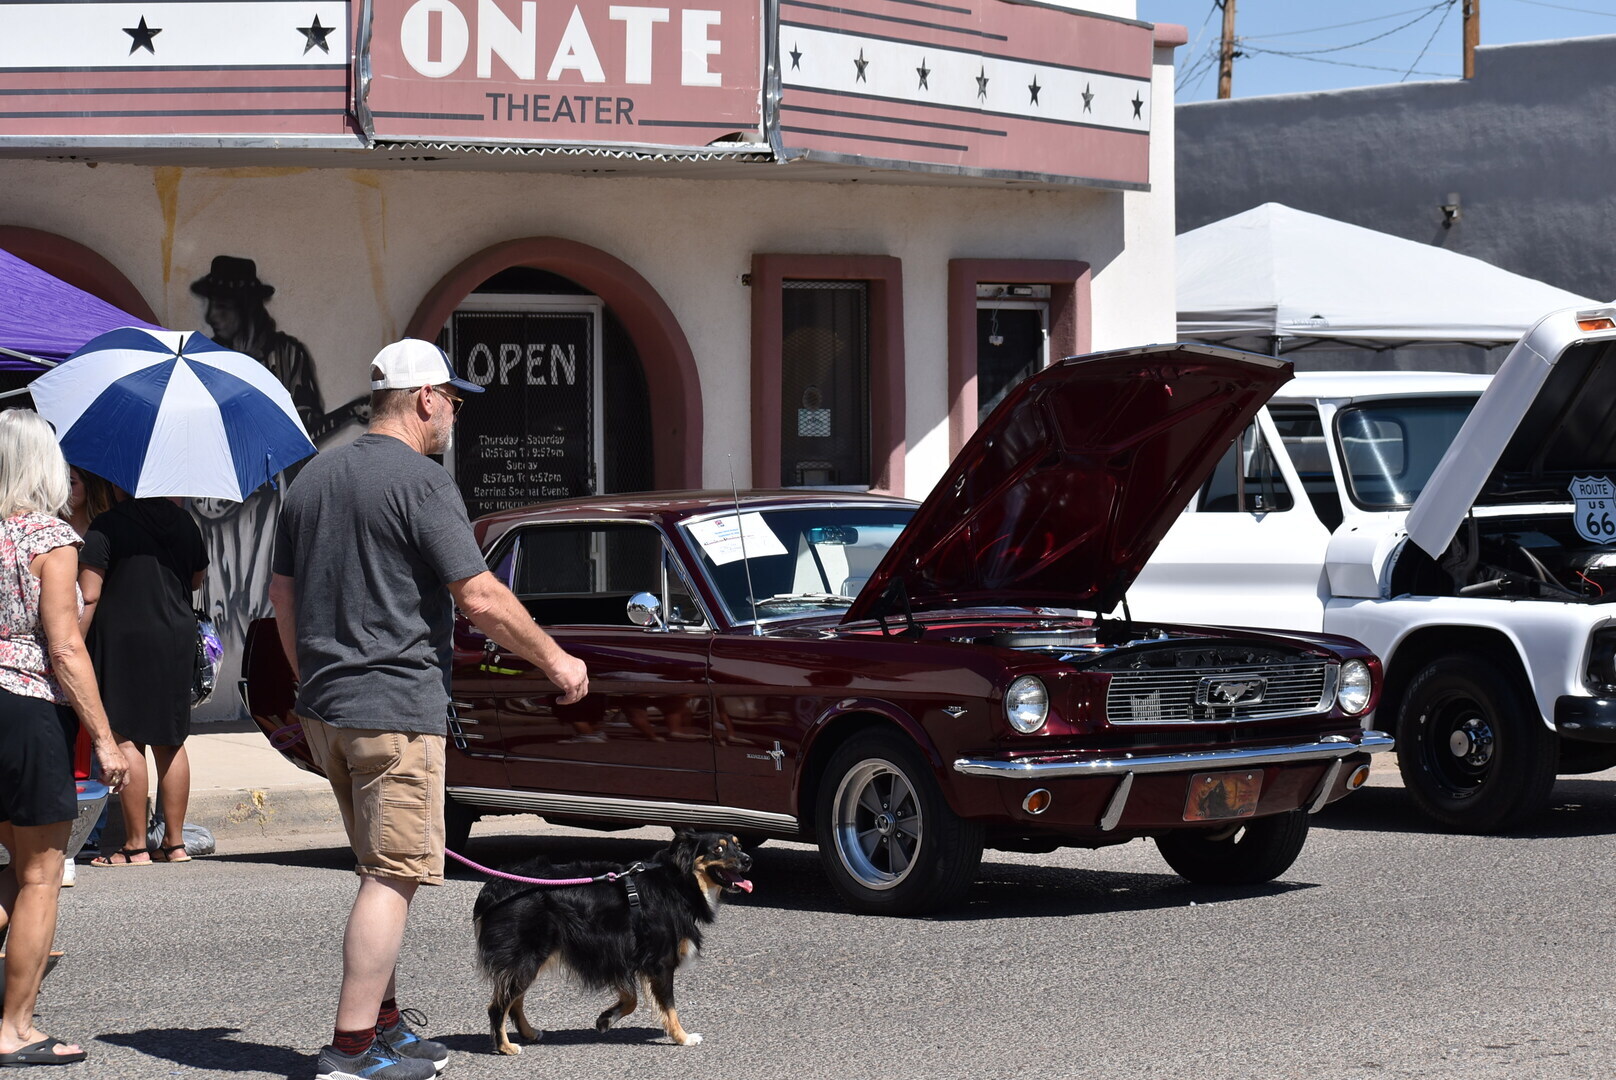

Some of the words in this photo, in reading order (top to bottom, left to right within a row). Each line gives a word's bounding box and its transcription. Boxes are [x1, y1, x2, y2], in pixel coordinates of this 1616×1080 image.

[400, 0, 722, 87] ONATE
[485, 92, 635, 126] THEATER
[467, 342, 576, 386] OPEN
[479, 434, 519, 446] Thursday
[526, 434, 565, 446] Saturday
[519, 447, 530, 458] T
[508, 486, 540, 497] Speial
[541, 486, 570, 497] Events
[1579, 483, 1609, 496] ROUTE
[1586, 511, 1616, 536] 66
